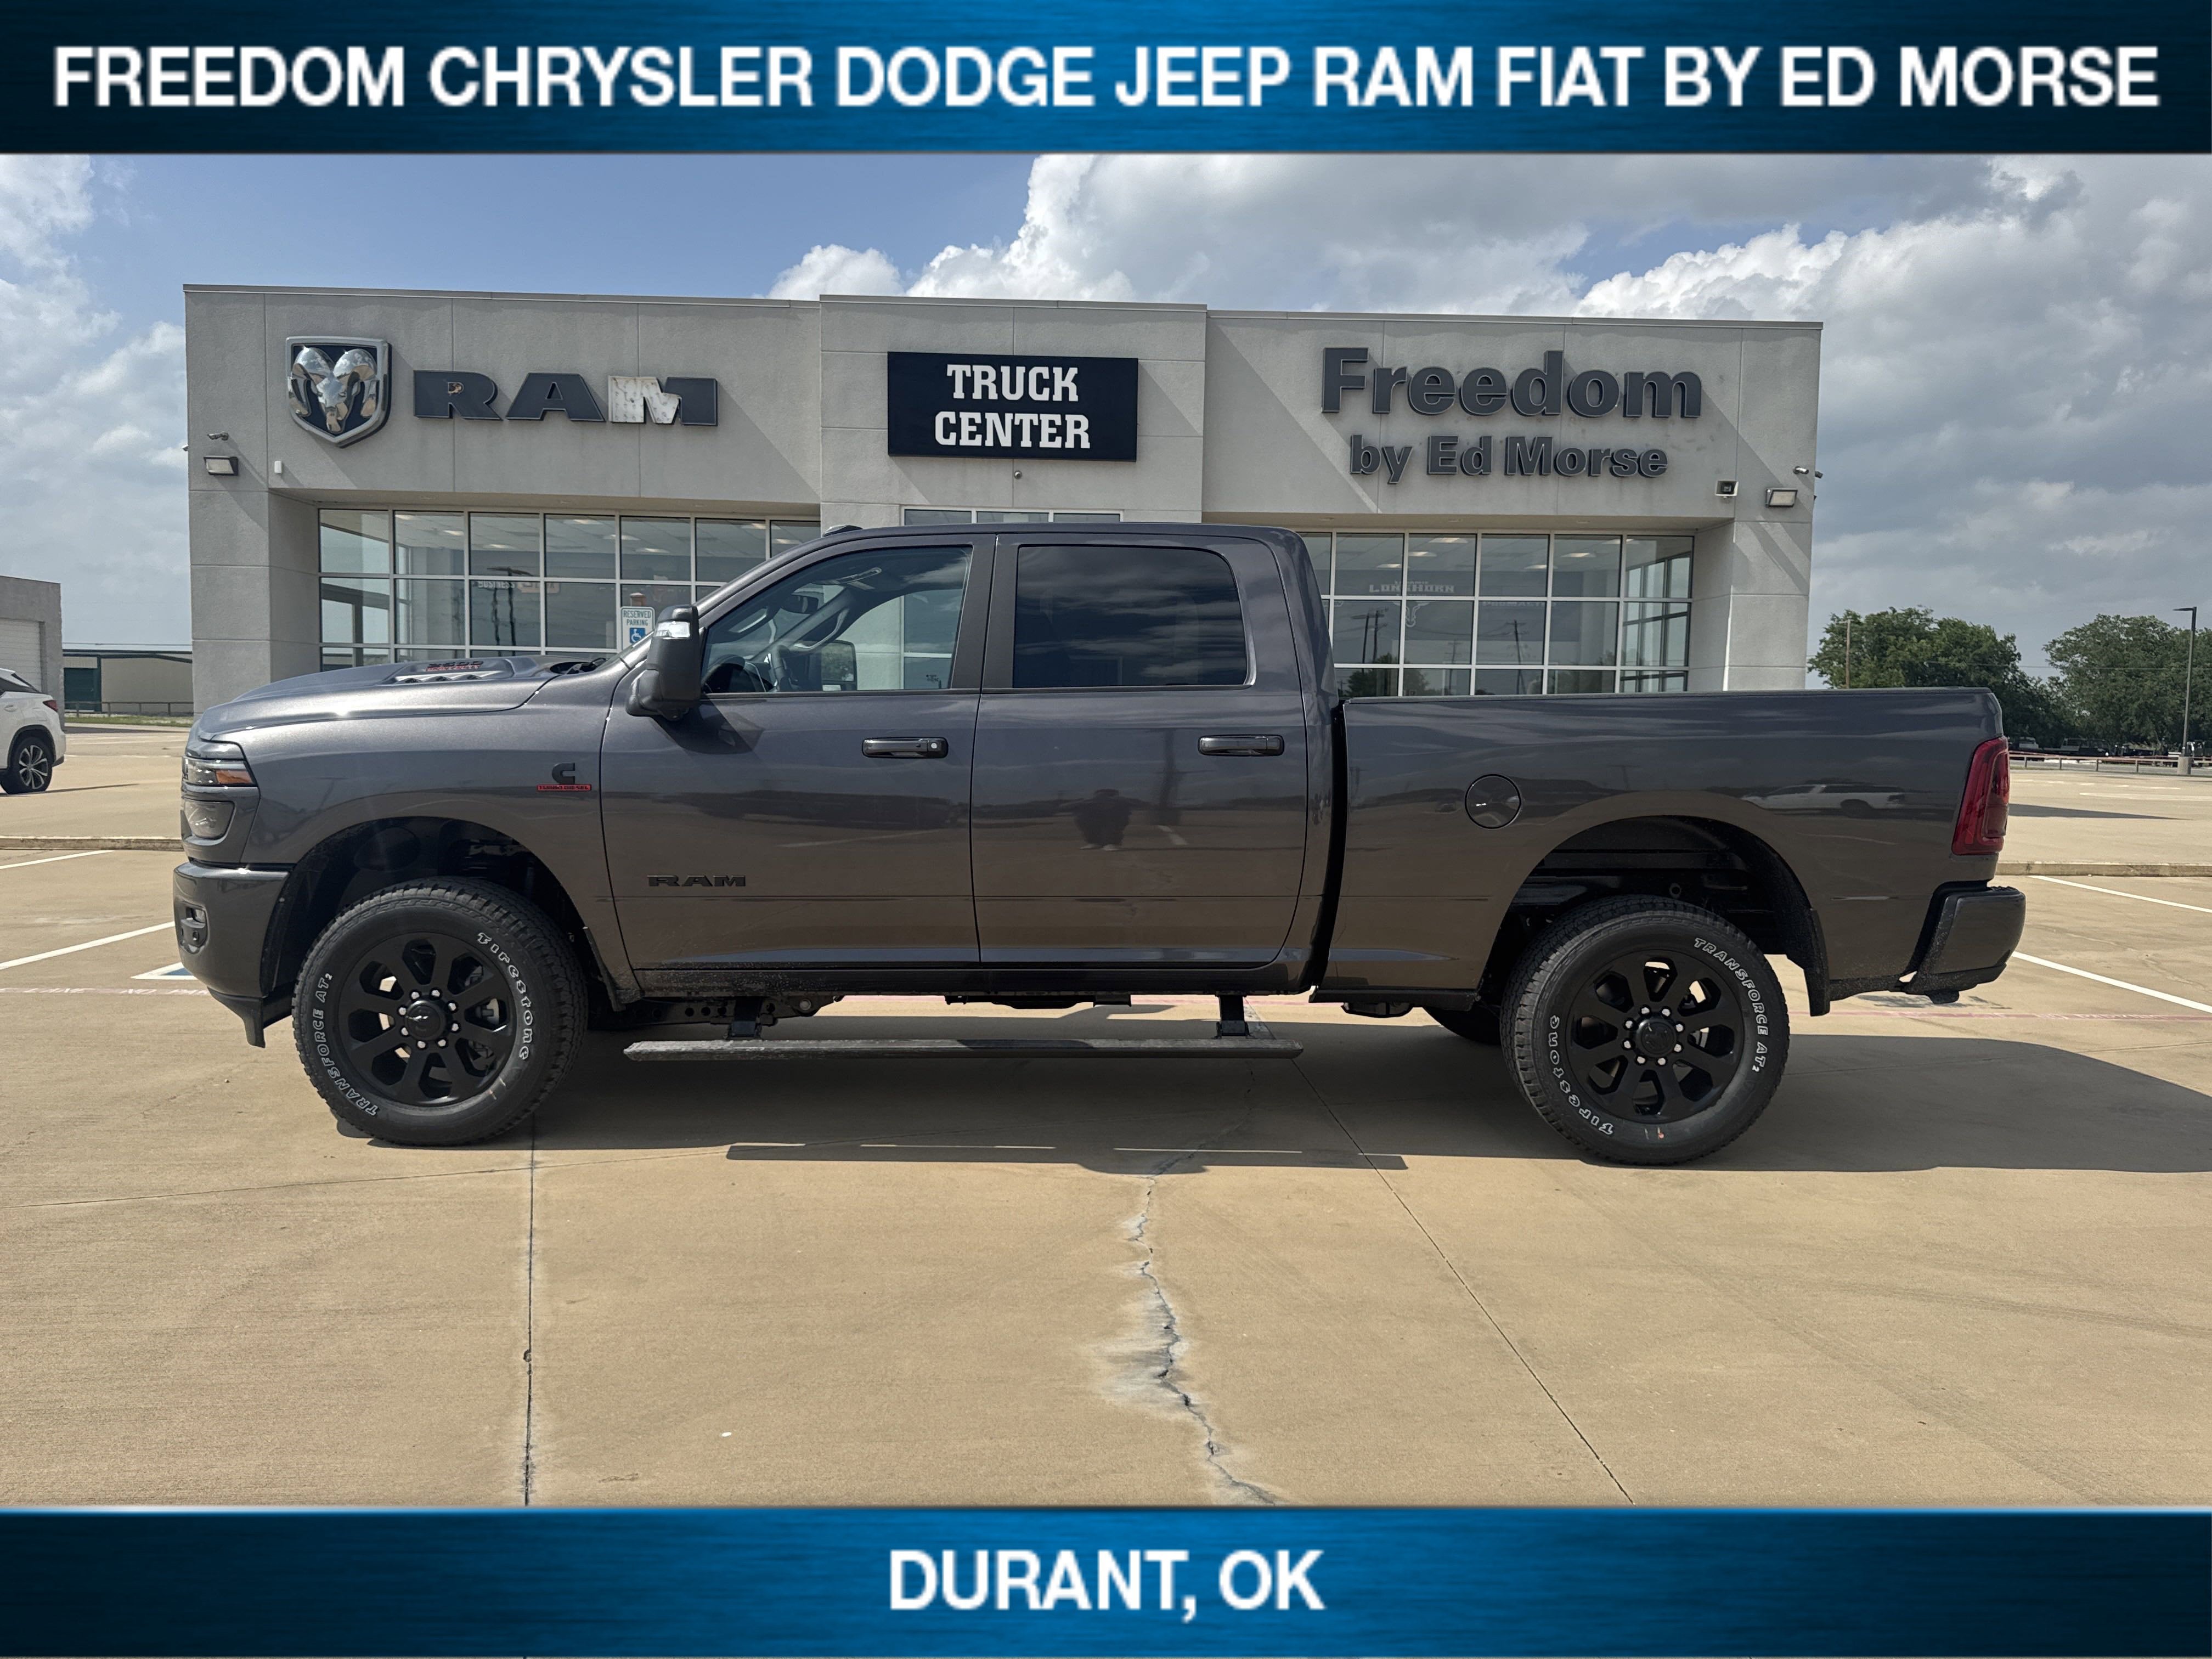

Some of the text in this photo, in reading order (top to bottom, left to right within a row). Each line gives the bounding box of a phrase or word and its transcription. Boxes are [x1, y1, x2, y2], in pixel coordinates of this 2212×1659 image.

[414, 369, 718, 426] RAM
[946, 364, 1079, 402] TRUCK
[1321, 347, 1703, 419] Freedom
[935, 411, 1091, 449] CENTER
[1350, 434, 1668, 484] by Ed Morse
[623, 610, 652, 619] RESERVED
[647, 874, 746, 887] RAM
[1694, 938, 1768, 1035] TRANSFORCE
[313, 1008, 379, 1116] TRANSFORCE
